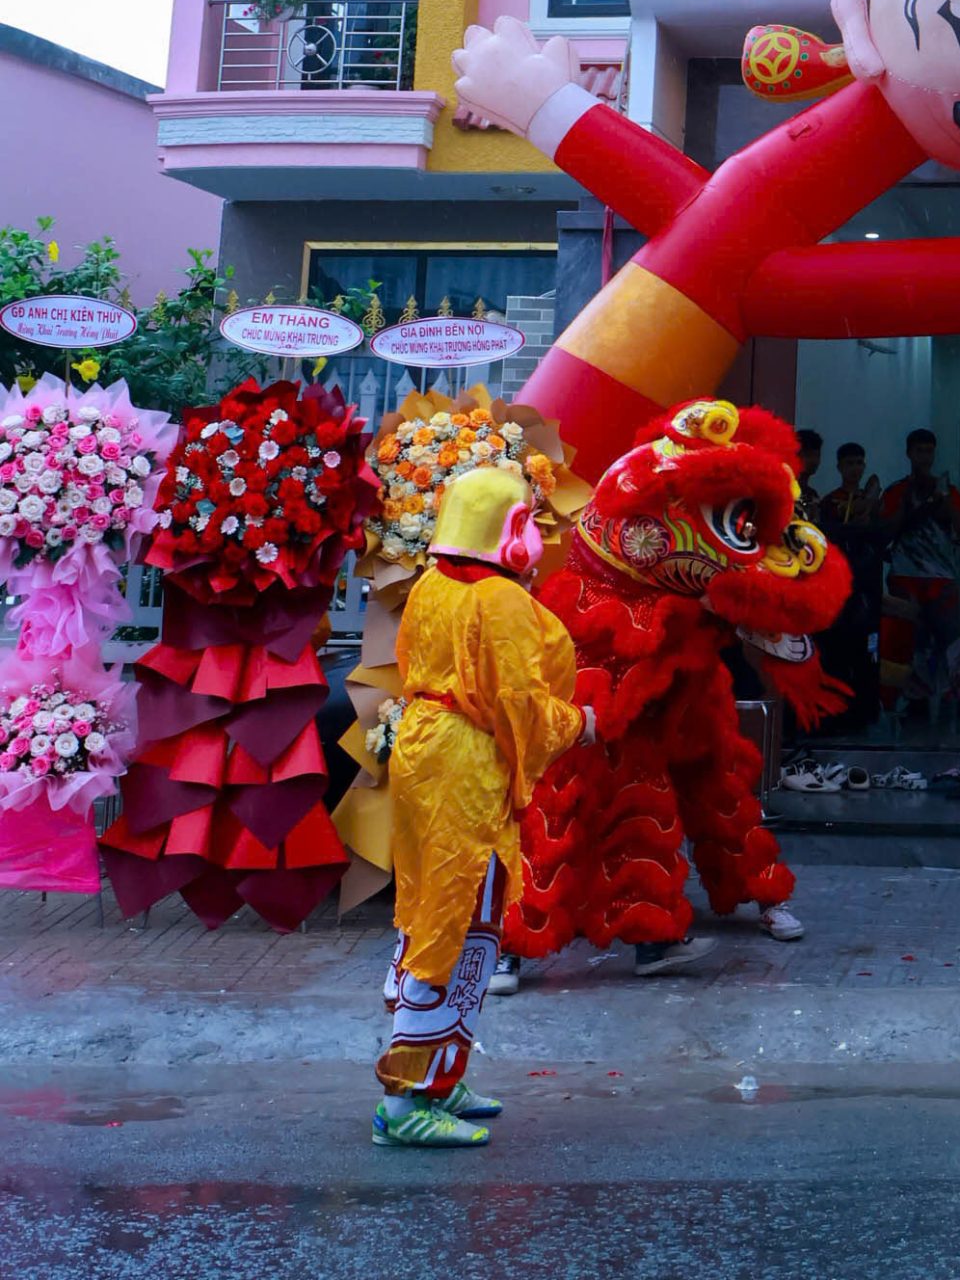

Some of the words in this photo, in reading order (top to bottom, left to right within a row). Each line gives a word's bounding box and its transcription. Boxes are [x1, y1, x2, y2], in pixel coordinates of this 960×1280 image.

[28, 307, 48, 319] ANH
[51, 308, 67, 323] CHỊ
[251, 312, 273, 324] EM
[400, 327, 416, 338] GIA
